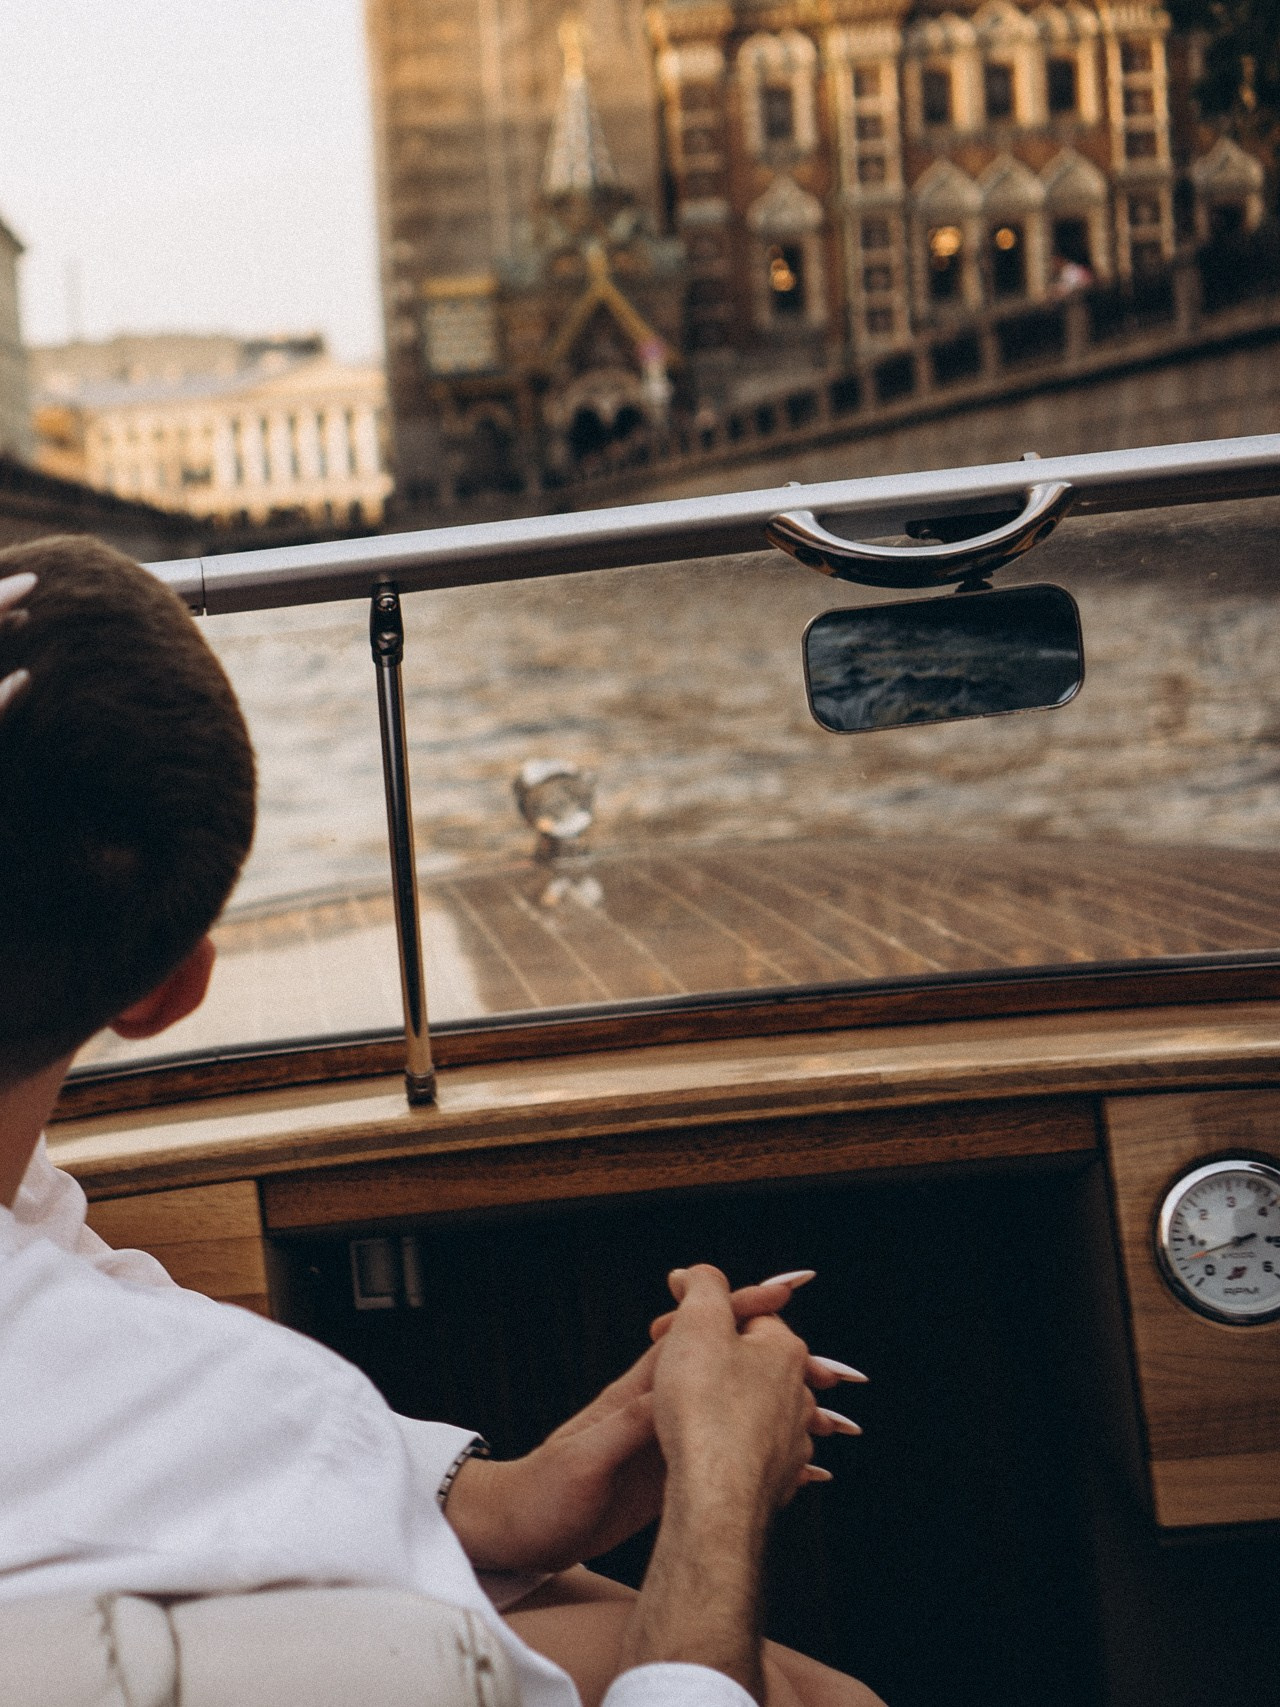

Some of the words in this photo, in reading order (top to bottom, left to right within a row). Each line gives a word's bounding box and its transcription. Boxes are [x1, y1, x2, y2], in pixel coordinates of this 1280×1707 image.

[1226, 1195, 1236, 1208] 3
[1199, 1209, 1208, 1220] 2
[1204, 1264, 1216, 1276] 0
[1223, 1286, 1260, 1295] RPM
